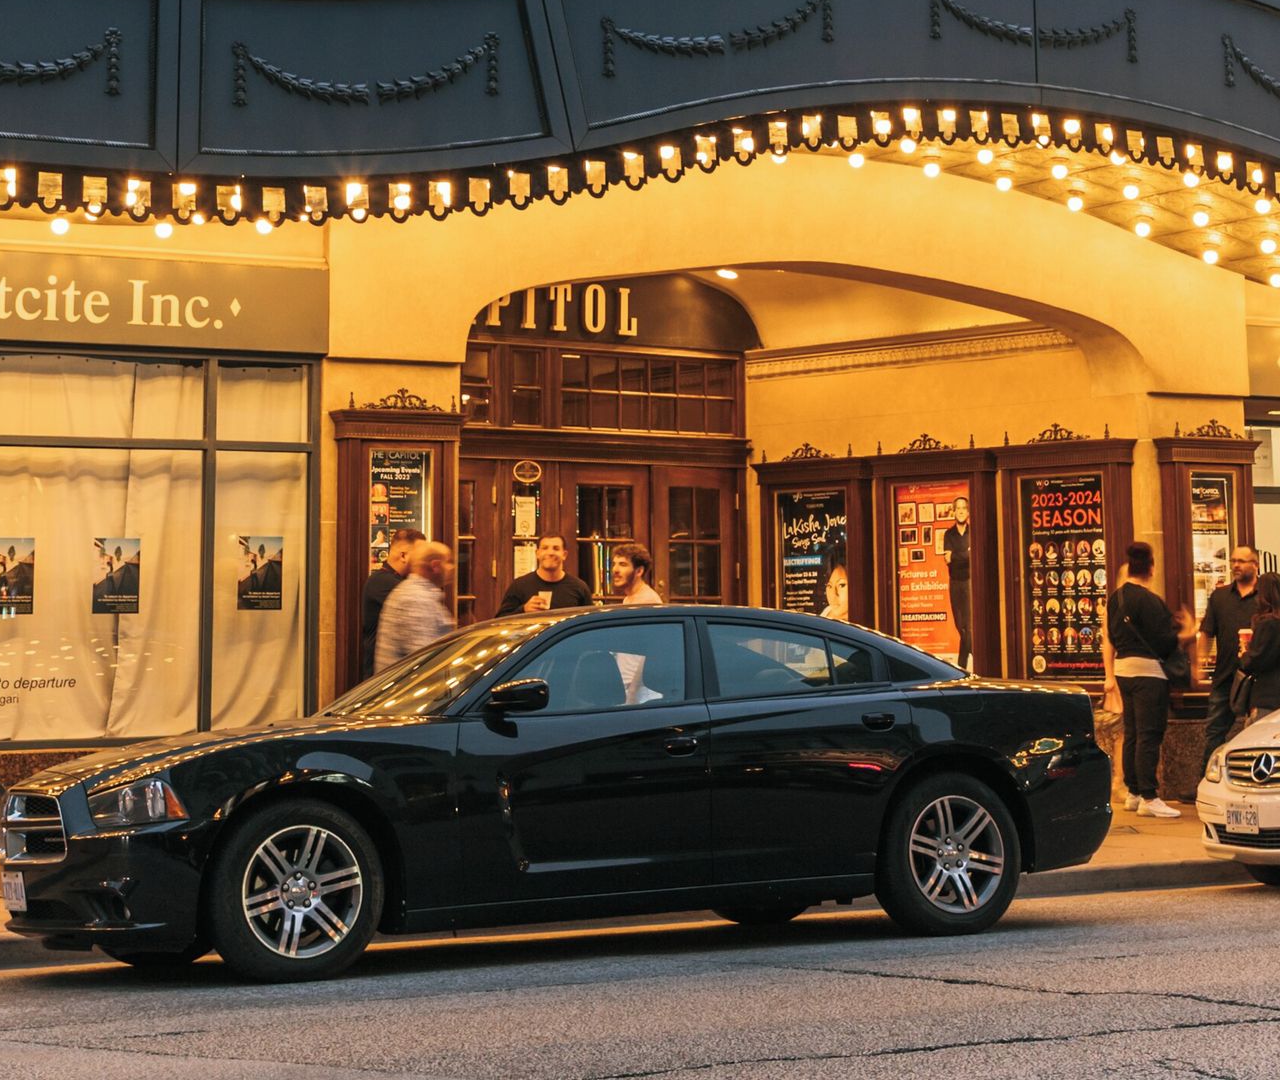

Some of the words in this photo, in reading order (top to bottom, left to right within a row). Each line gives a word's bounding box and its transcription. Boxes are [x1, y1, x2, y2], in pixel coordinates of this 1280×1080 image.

[127, 279, 224, 330] Inc.
[484, 283, 638, 337] PITOL
[388, 451, 421, 460] CAPITOL
[401, 466, 421, 474] Events
[1031, 490, 1102, 508] 2023-2024
[824, 513, 847, 531] Jone
[1032, 508, 1101, 528] SEASON
[910, 580, 949, 591] Exhibition
[13, 677, 76, 691] departure
